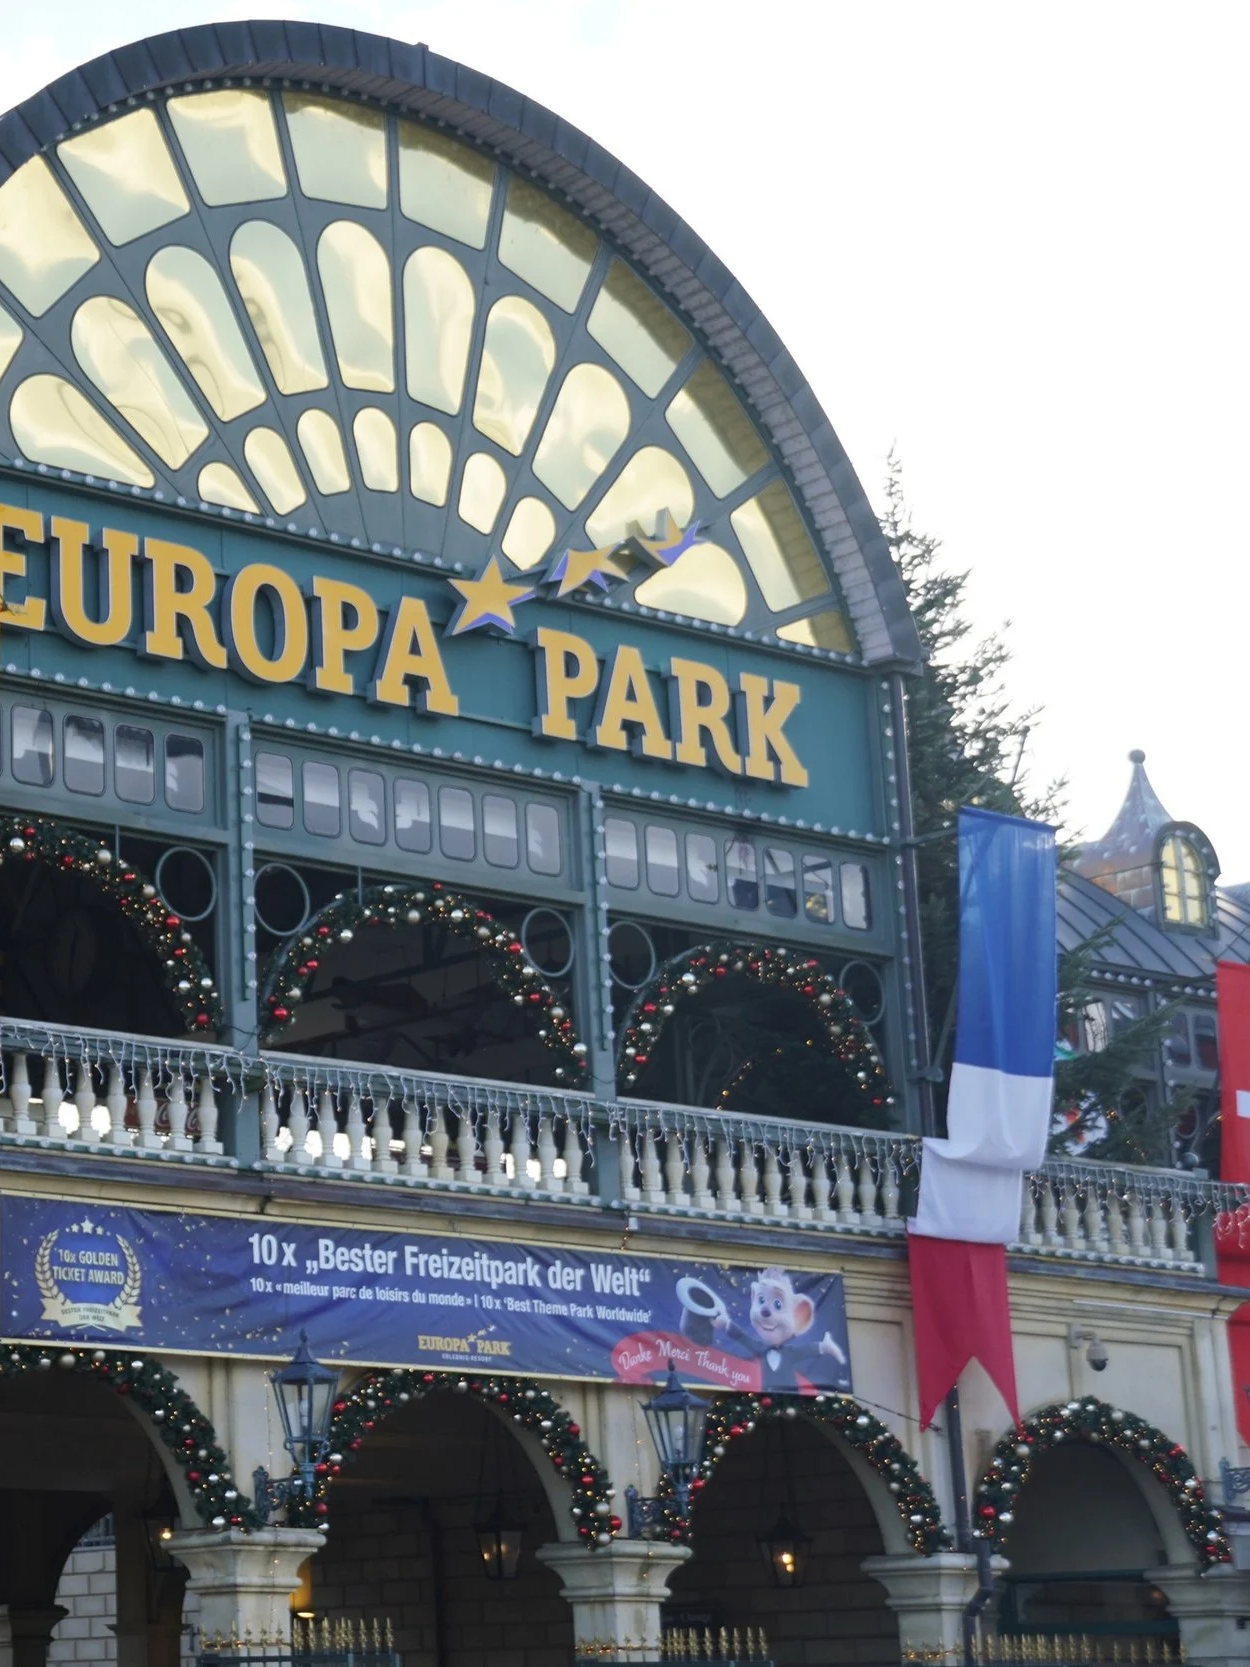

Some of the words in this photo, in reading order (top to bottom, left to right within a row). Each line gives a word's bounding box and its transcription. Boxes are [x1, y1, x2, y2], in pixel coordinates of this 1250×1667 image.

[533, 626, 810, 789] PARK
[52, 1266, 86, 1282] TICKET
[88, 1269, 125, 1285] AWARD
[79, 1250, 118, 1267] GOLDEN
[404, 1245, 542, 1290] Freizeitpark
[547, 1260, 585, 1292] der
[333, 1286, 356, 1300] parc
[358, 1285, 373, 1300] de
[375, 1287, 409, 1302] loisirs
[412, 1289, 426, 1304] du
[532, 1299, 568, 1316] Theme
[570, 1303, 594, 1319] Park
[418, 1335, 470, 1352] EUROPA
[477, 1340, 511, 1355] PARK
[618, 1342, 653, 1370] Danke
[655, 1339, 691, 1362] Merci
[695, 1351, 729, 1378] Thank
[730, 1371, 751, 1386] you
